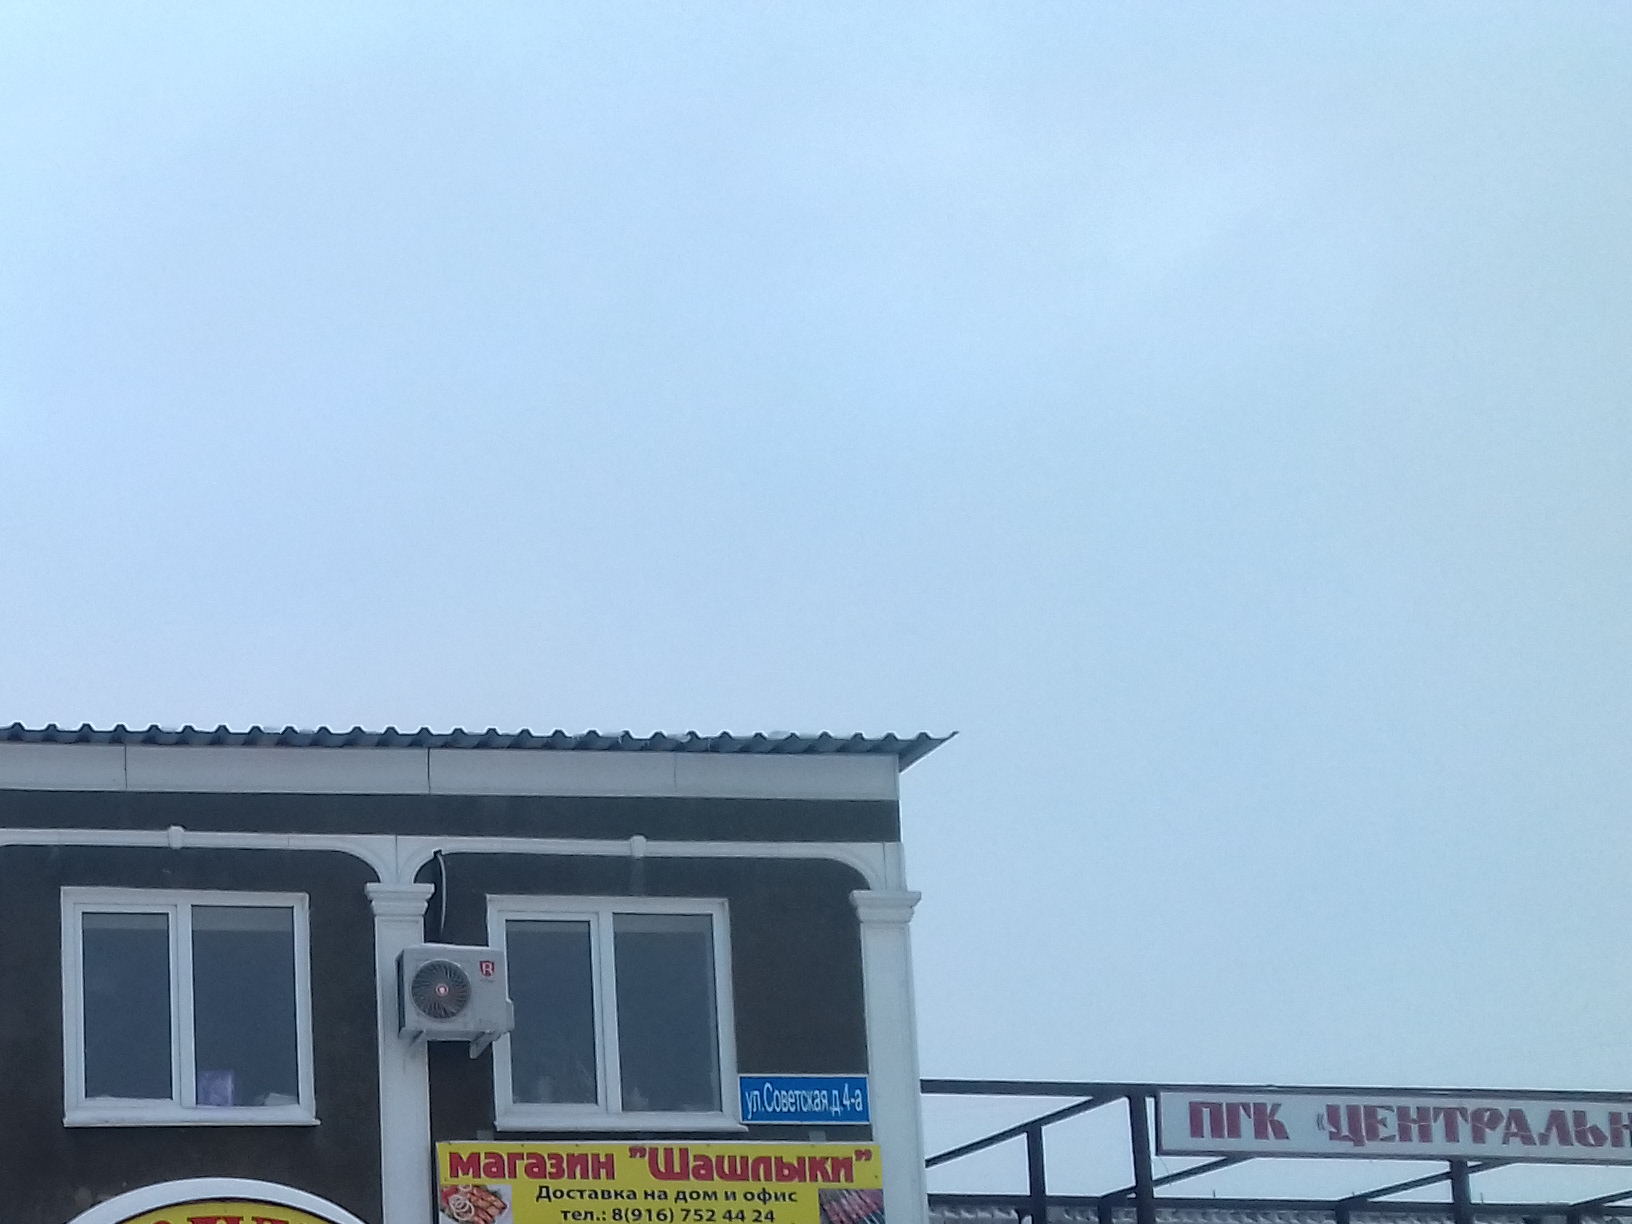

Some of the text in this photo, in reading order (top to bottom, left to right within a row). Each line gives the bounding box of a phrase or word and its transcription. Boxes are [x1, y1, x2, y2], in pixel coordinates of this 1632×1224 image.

[1188, 1101, 1289, 1140] ПГК
[449, 1151, 616, 1181] магазин
[536, 1185, 798, 1205] Доставка на дом и офис
[561, 1207, 776, 1224] тел.: 8(916) 752 44 24
